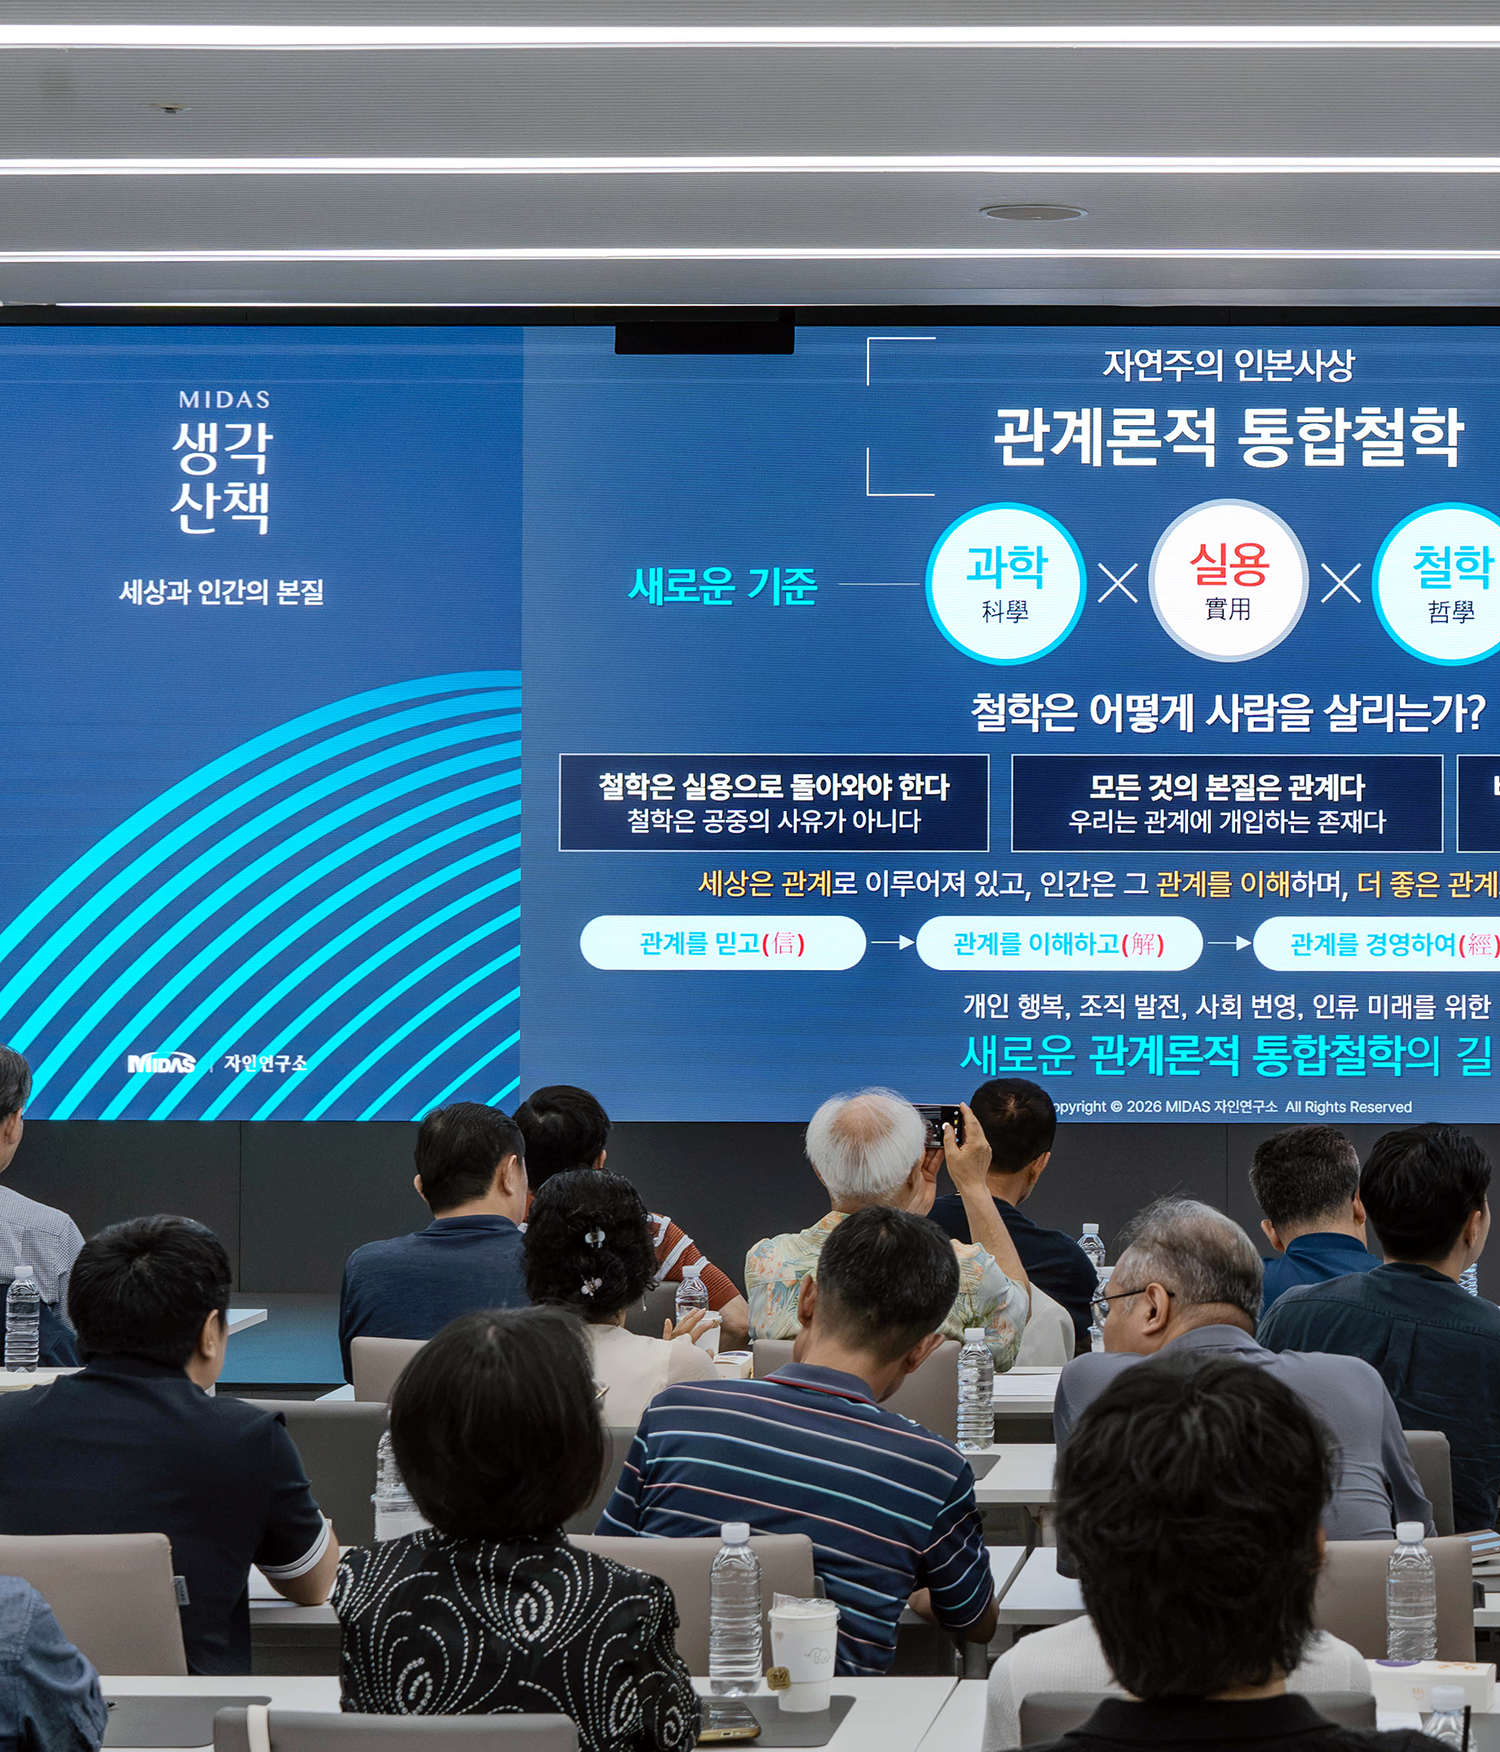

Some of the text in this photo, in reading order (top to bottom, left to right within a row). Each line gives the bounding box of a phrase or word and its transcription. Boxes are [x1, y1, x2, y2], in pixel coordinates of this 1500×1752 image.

[1102, 348, 1357, 383] 자연주의 인본사상
[179, 390, 270, 409] MIDAS
[171, 422, 274, 476] 생각
[994, 406, 1465, 469] 관계론적 통합철학
[170, 481, 269, 535] 산책
[966, 545, 1049, 590] 과학
[1189, 542, 1270, 587] 실용
[1413, 545, 1496, 591] 철학
[118, 578, 324, 606] 세상과 인간의 본질
[627, 566, 818, 607] 새로운 기준
[982, 599, 1029, 624] 科學
[1205, 596, 1251, 623] 實用
[1428, 599, 1475, 625] 哲學
[971, 692, 1486, 734] 철학은 어떻게 사람을 살리는가?
[598, 772, 951, 802] 철학은 실용으로 돌아와야 한다
[1089, 773, 1367, 802] 모든 것의 본질은 관계다
[627, 808, 922, 834] 철학은 공중의 사유가 아니다
[1068, 808, 1387, 835] 우리는 관계에 개입하는 존재다
[698, 869, 775, 898] 세상은
[781, 869, 858, 898] 관계로
[866, 869, 965, 898] 이루어져
[974, 869, 1032, 902] 있고,
[1040, 869, 1117, 898] 인간은
[1123, 872, 1150, 894] 그
[1156, 870, 1233, 898] 관계를
[1240, 870, 1349, 903] 이해하며,
[1357, 870, 1381, 899] 더
[1389, 870, 1441, 899] 좋은
[640, 931, 709, 956] 관계를
[953, 931, 1022, 957] 관계를
[1290, 932, 1360, 957] 관계를
[963, 993, 1492, 1021] 개인 행복, 조직 발전, 사회 번영, 인류 미래를 위한
[127, 1051, 197, 1075] MIDAS
[223, 1053, 308, 1074] 자인연구소
[959, 1034, 1492, 1077] 새로운 관계론적 통합철학의 길
[1053, 1099, 1108, 1116] opyright
[1126, 1100, 1163, 1113] 2026
[1165, 1100, 1211, 1113] MIDAS
[1213, 1099, 1279, 1114] 자인연구소
[1284, 1100, 1302, 1113] All
[1305, 1100, 1347, 1116] Rights
[1350, 1100, 1413, 1114] Reserved
